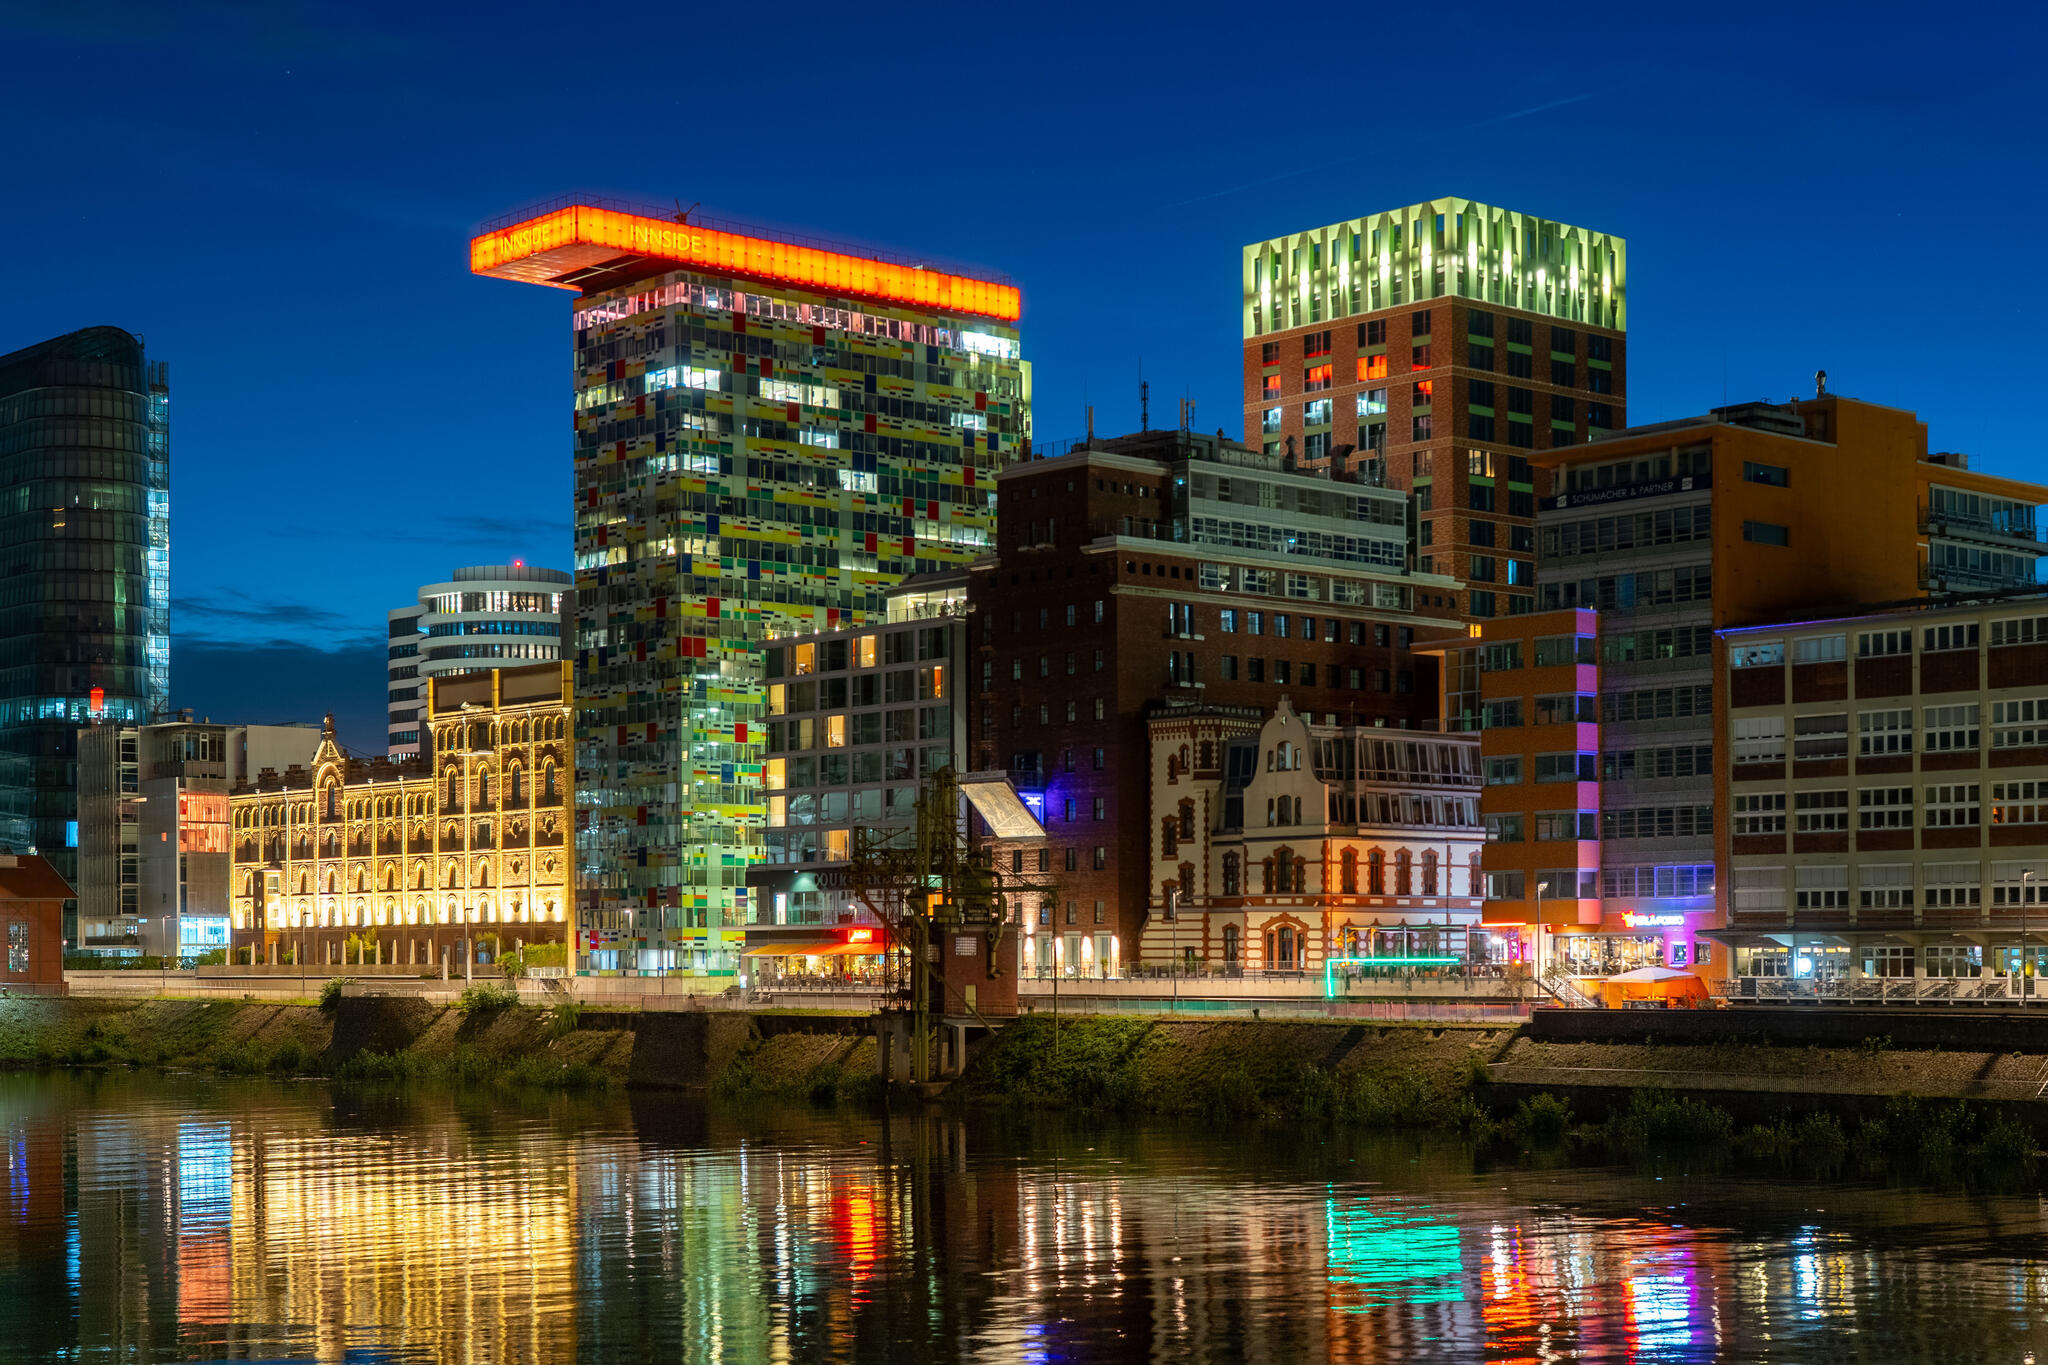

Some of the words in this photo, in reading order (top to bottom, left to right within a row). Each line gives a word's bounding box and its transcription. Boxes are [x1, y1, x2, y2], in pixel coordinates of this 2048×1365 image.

[501, 223, 550, 254] INNSIDE
[630, 224, 701, 254] INNSIDE
[1639, 482, 1674, 495] PARTNER
